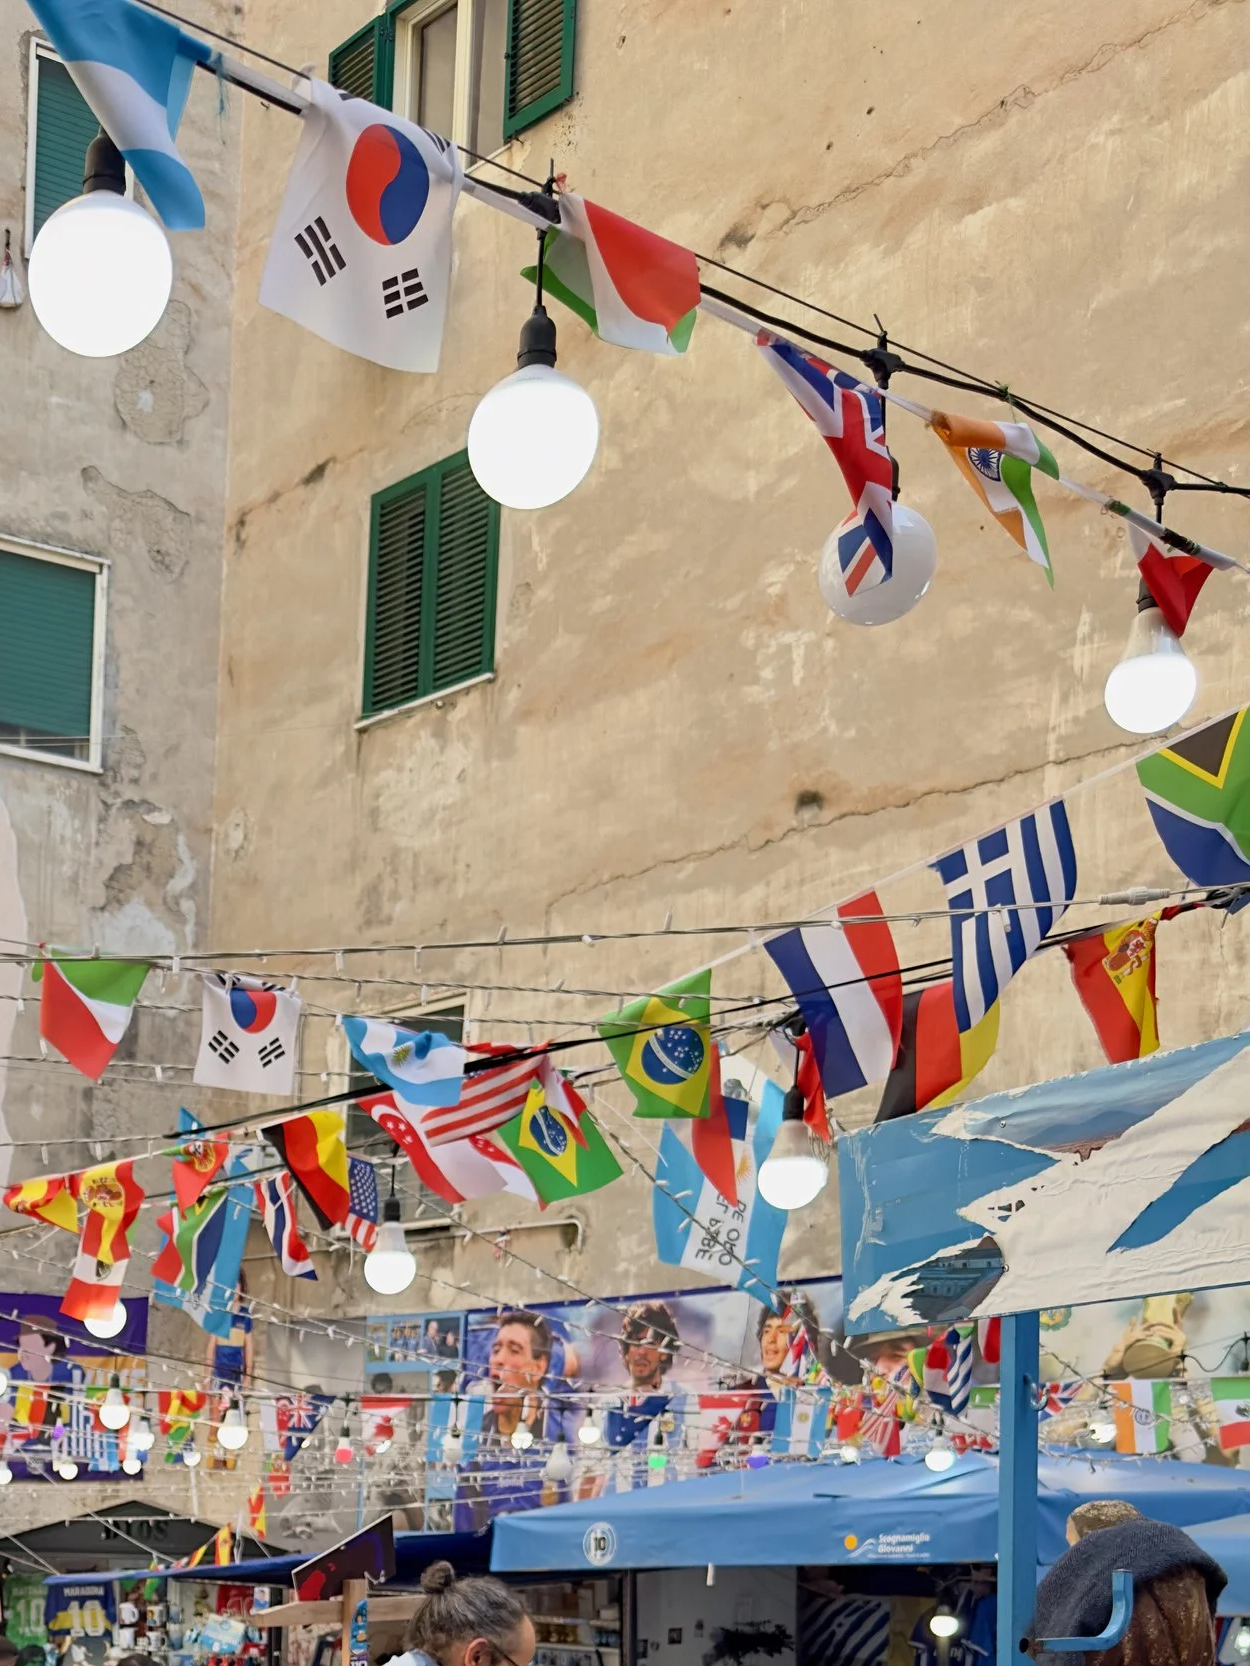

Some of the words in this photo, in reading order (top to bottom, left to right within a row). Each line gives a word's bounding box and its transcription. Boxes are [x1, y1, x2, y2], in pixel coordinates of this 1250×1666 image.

[878, 1532, 930, 1545] Scognamiglio
[877, 1543, 914, 1554] Giovanni
[63, 1585, 105, 1597] MARADONA
[68, 1599, 106, 1637] 10
